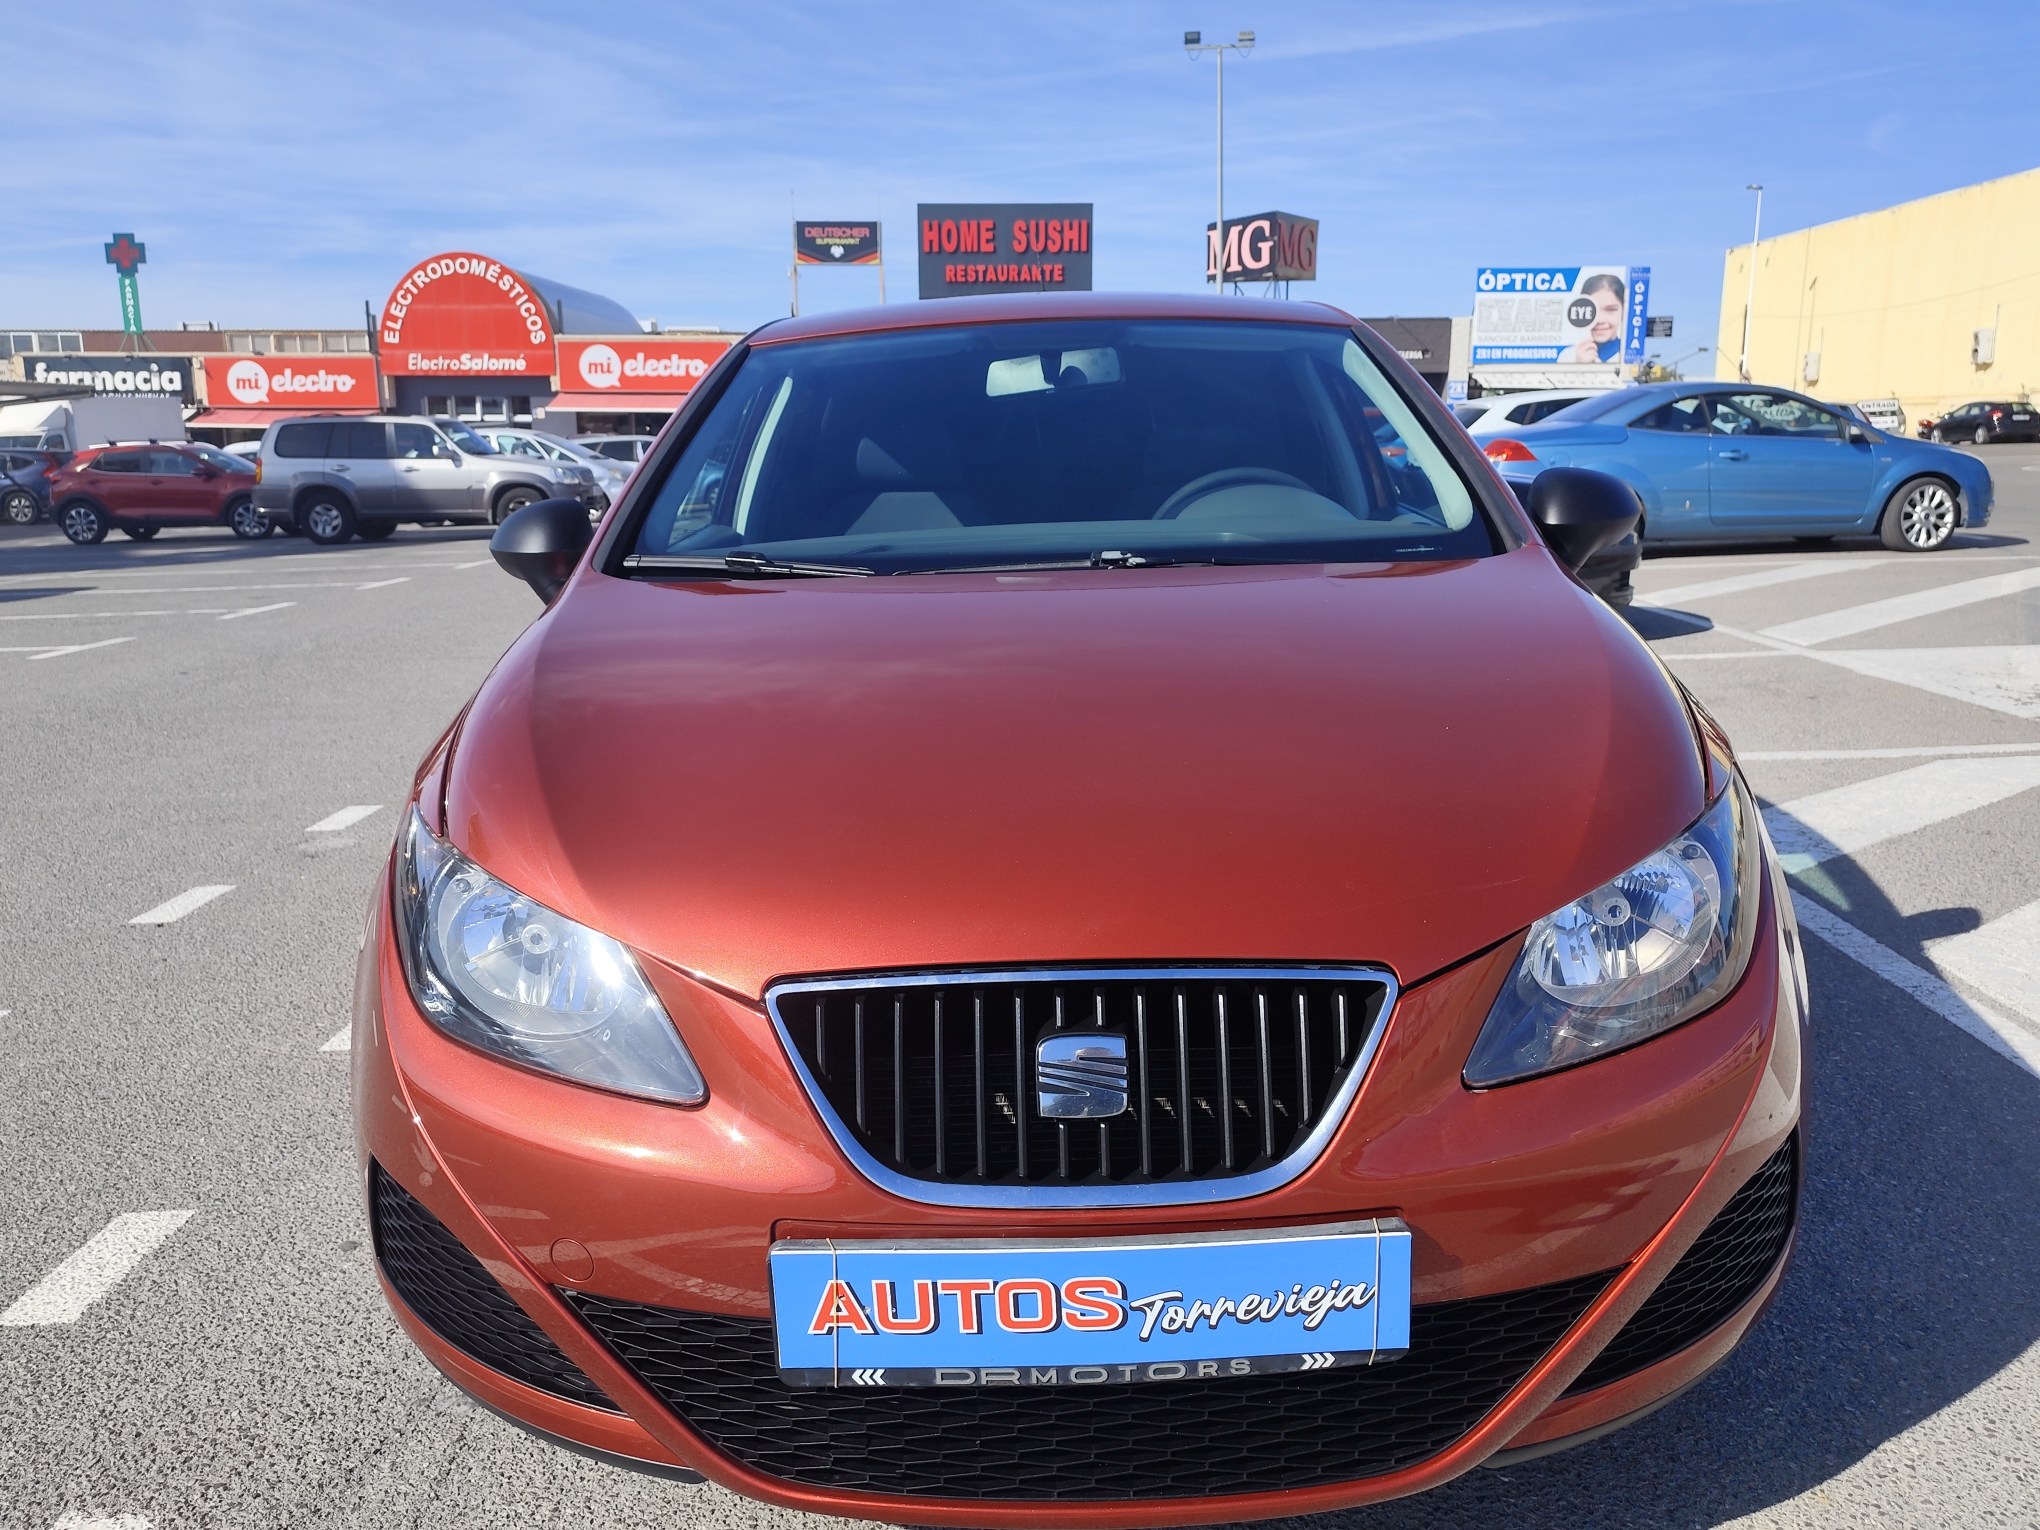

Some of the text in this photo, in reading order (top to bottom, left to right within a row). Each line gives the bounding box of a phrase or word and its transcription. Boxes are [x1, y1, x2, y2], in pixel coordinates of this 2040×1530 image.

[804, 226, 870, 237] DEUTSCHER
[923, 219, 1088, 253] HOME SUSHI
[1207, 219, 1274, 275] MG
[1277, 221, 1315, 272] MG
[945, 264, 1064, 283] RESTAURANTE
[1478, 269, 1567, 291] ÓPTICA
[124, 279, 137, 332] FARMACIA
[384, 257, 546, 345] ELECTRODOMÉSTICOS
[1570, 306, 1593, 320] EYE
[408, 353, 527, 371] ElectroSalomé
[588, 352, 709, 377] mi electro
[34, 362, 183, 391] farmacia
[236, 368, 356, 393] mi electro
[807, 1277, 1378, 1341] AUTOS Torrevieja
